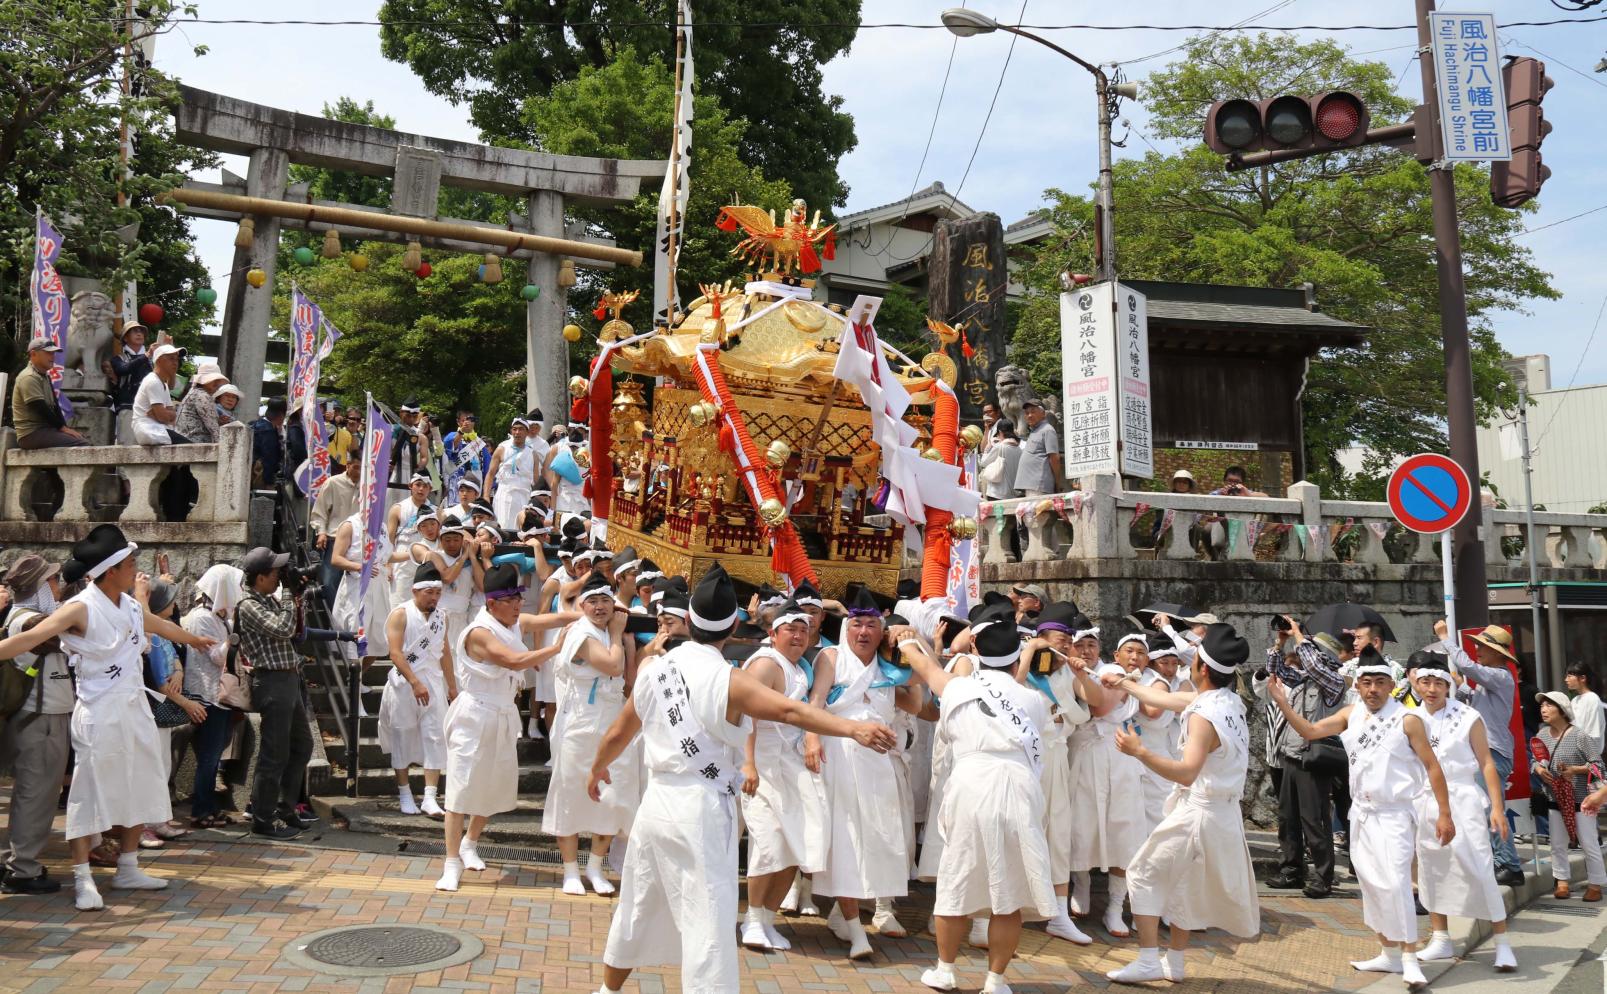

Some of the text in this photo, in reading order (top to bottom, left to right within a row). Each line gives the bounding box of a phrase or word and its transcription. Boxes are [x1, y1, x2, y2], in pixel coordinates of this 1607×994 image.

[1439, 19, 1467, 152] Fuji Hachimangu Shrine
[1460, 19, 1500, 153] 風治八幡宮前
[1079, 311, 1097, 378] 風治八幡宮
[1128, 313, 1140, 378] 風治八幡宮
[1072, 395, 1108, 413] 初宮詣
[1072, 411, 1110, 430] 厄除祈願
[1072, 428, 1110, 446] 安産祈願
